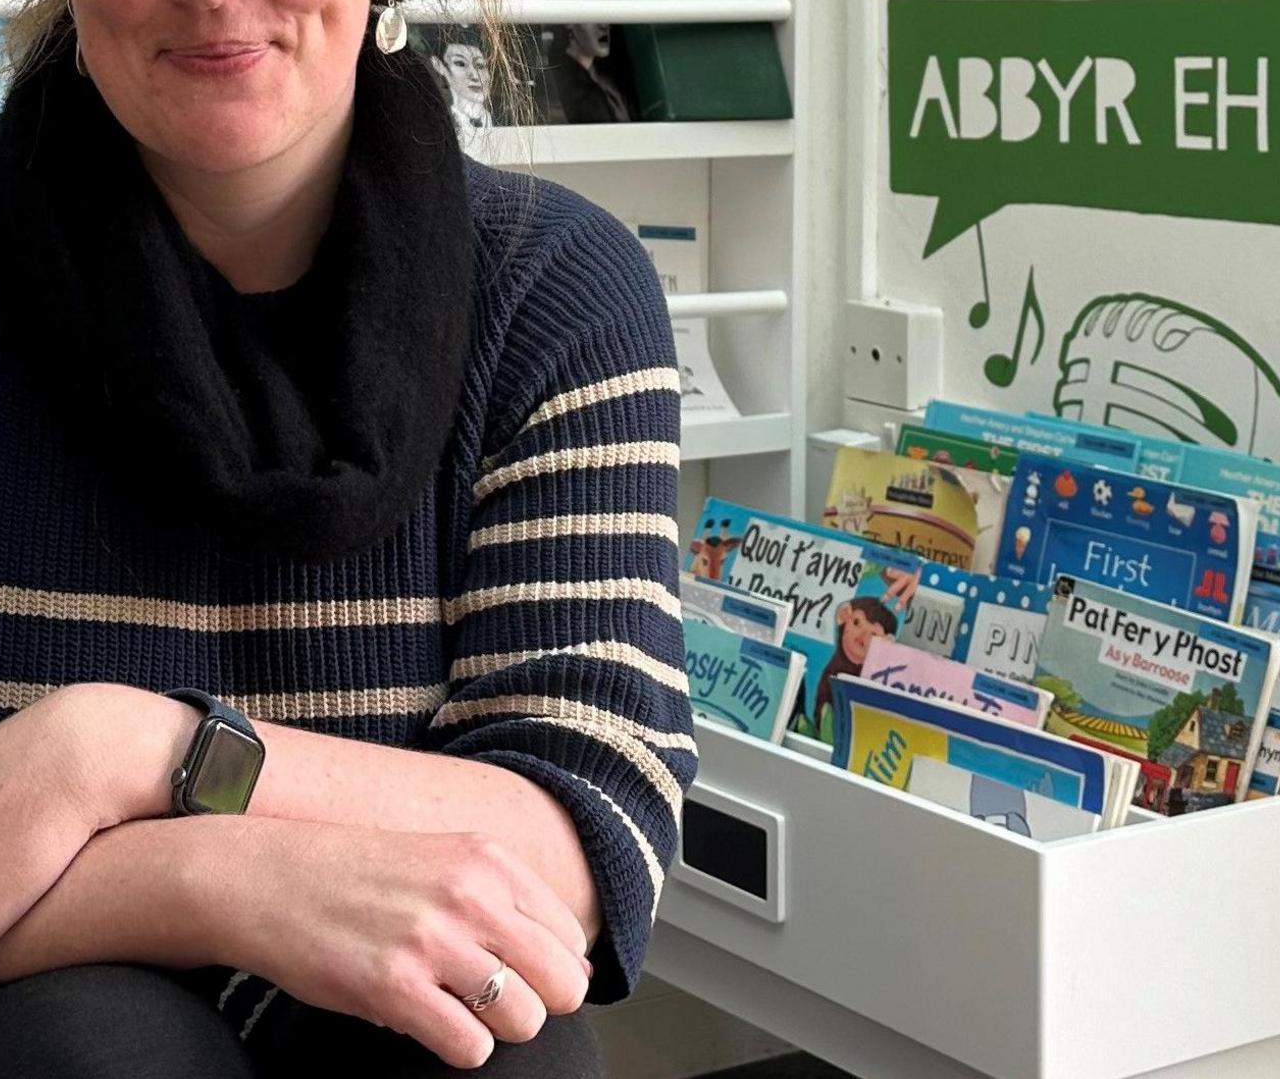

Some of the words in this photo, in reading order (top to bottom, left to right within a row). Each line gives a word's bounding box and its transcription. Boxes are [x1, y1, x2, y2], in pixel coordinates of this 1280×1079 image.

[909, 53, 1142, 146] ABBYR
[1173, 55, 1270, 153] EH
[741, 524, 789, 568] Quoi
[1084, 541, 1152, 587] First
[1070, 597, 1110, 632] Pat
[1113, 610, 1151, 645] Fer
[1154, 630, 1170, 656] y
[1174, 631, 1243, 677] Phost
[1132, 652, 1191, 686] Barroose
